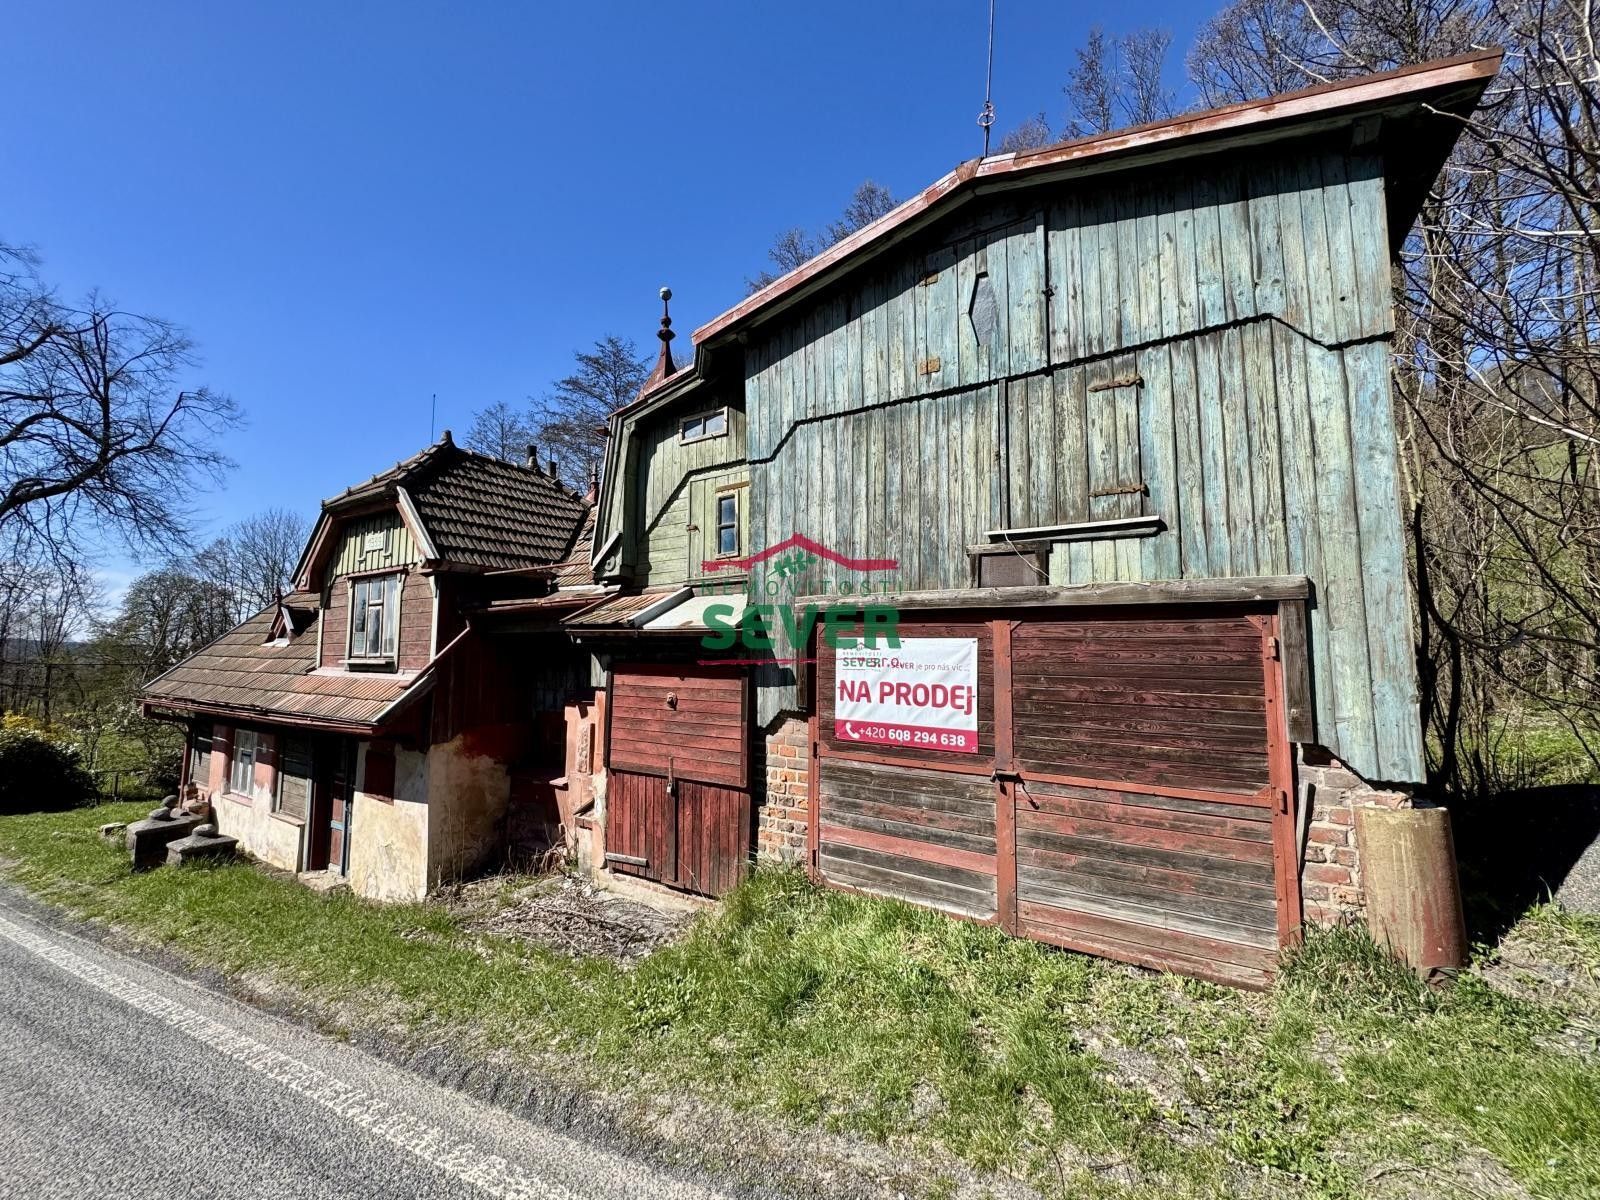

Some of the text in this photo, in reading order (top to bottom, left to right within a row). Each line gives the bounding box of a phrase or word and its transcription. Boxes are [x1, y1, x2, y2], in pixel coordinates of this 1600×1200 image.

[842, 657, 881, 667] SEVER
[924, 664, 935, 672] pro
[839, 680, 973, 715] NA PRODEJ
[859, 727, 966, 746] +420 608 294 638
